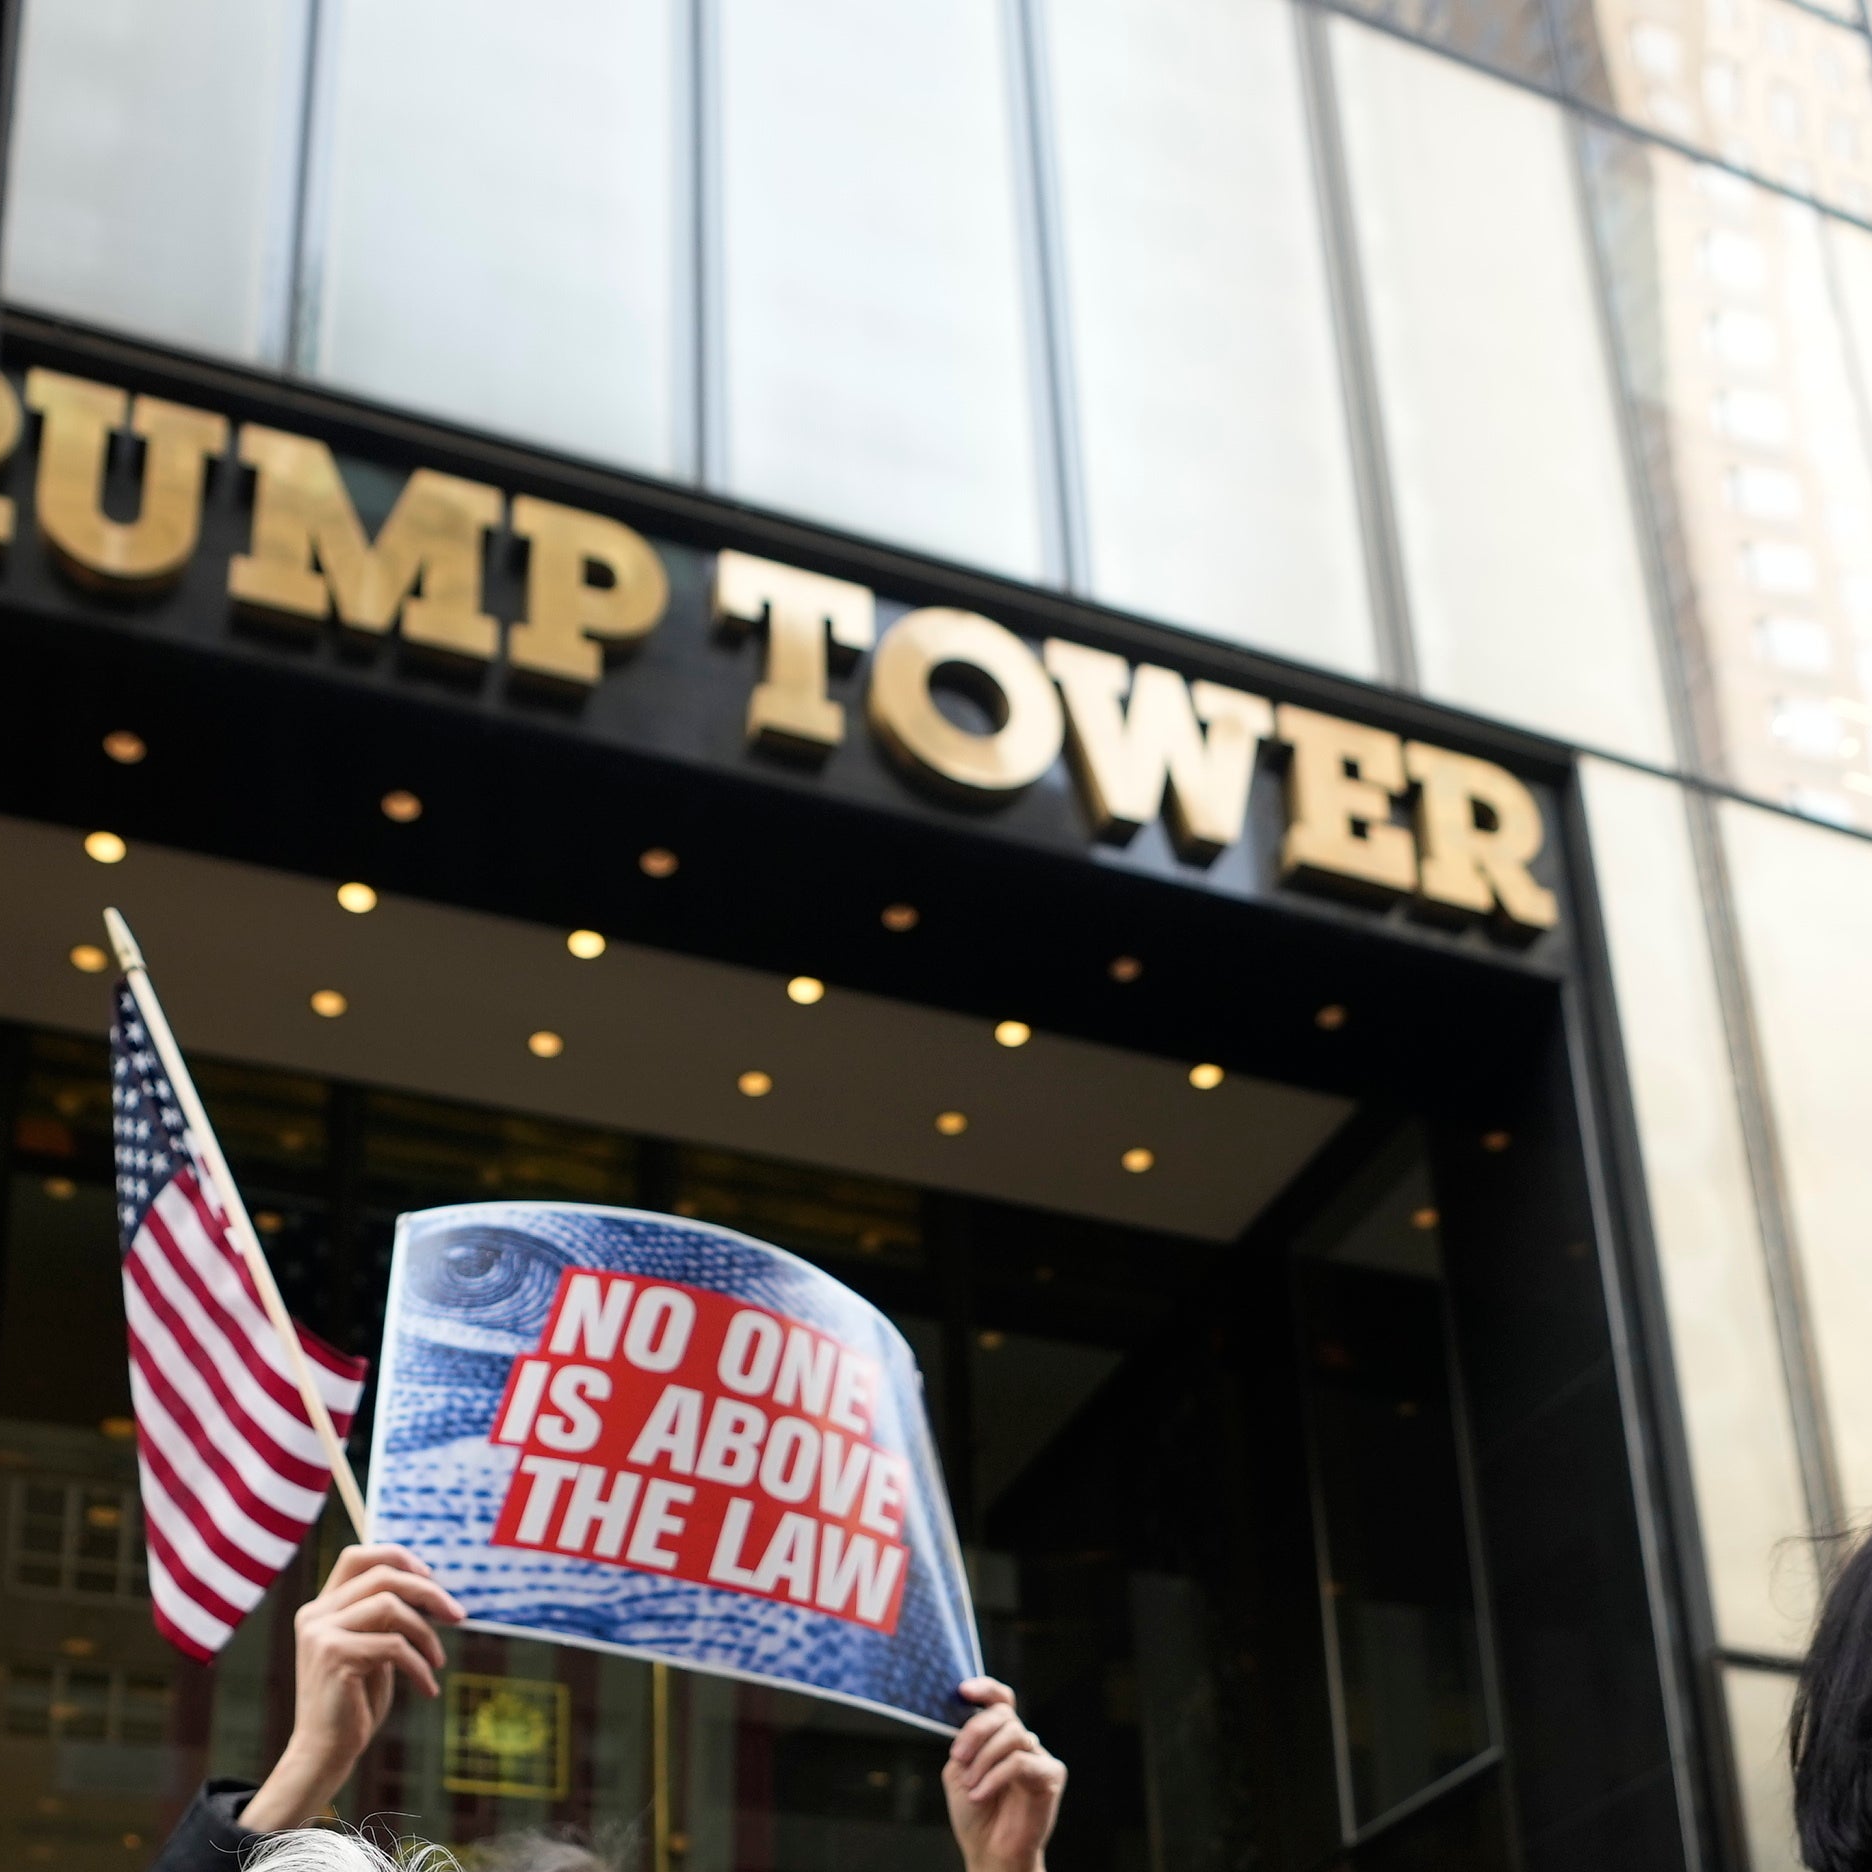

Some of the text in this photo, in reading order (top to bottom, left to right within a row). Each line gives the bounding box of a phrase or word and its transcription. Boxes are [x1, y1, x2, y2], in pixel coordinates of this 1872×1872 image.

[714, 548, 1558, 934] TOWER
[549, 1272, 878, 1437] NO ONE
[498, 1359, 906, 1538] IS ABOVE
[514, 1455, 904, 1625] THE LAW
